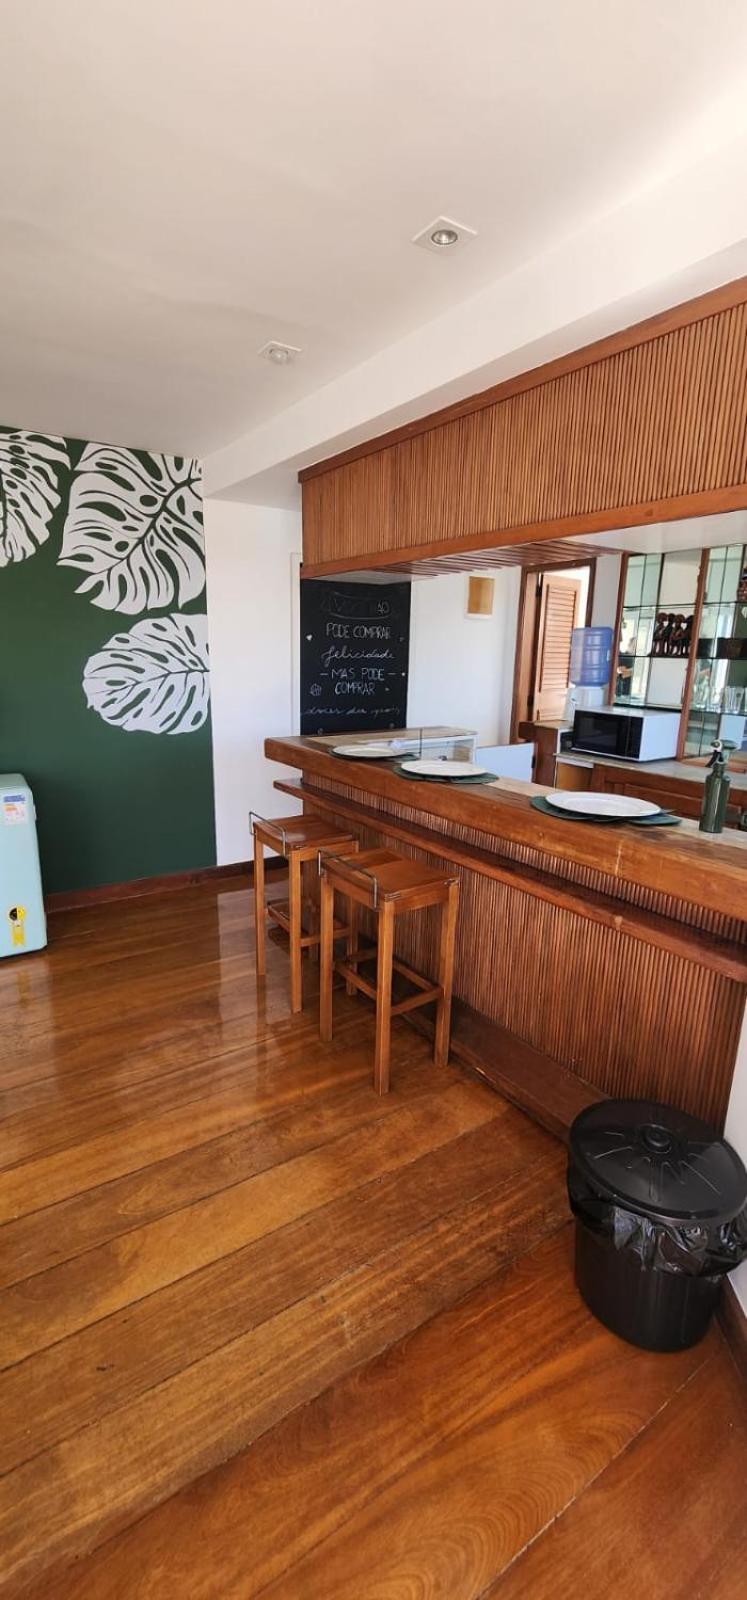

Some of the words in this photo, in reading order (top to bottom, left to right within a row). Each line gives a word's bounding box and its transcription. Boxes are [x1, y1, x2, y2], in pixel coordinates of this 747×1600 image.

[326, 622, 350, 638] PODE
[353, 625, 392, 639] COMPRAR
[321, 645, 396, 668] felicidade
[331, 667, 355, 679] MAS
[361, 667, 385, 681] PODE
[334, 681, 376, 695] COMPRAR
